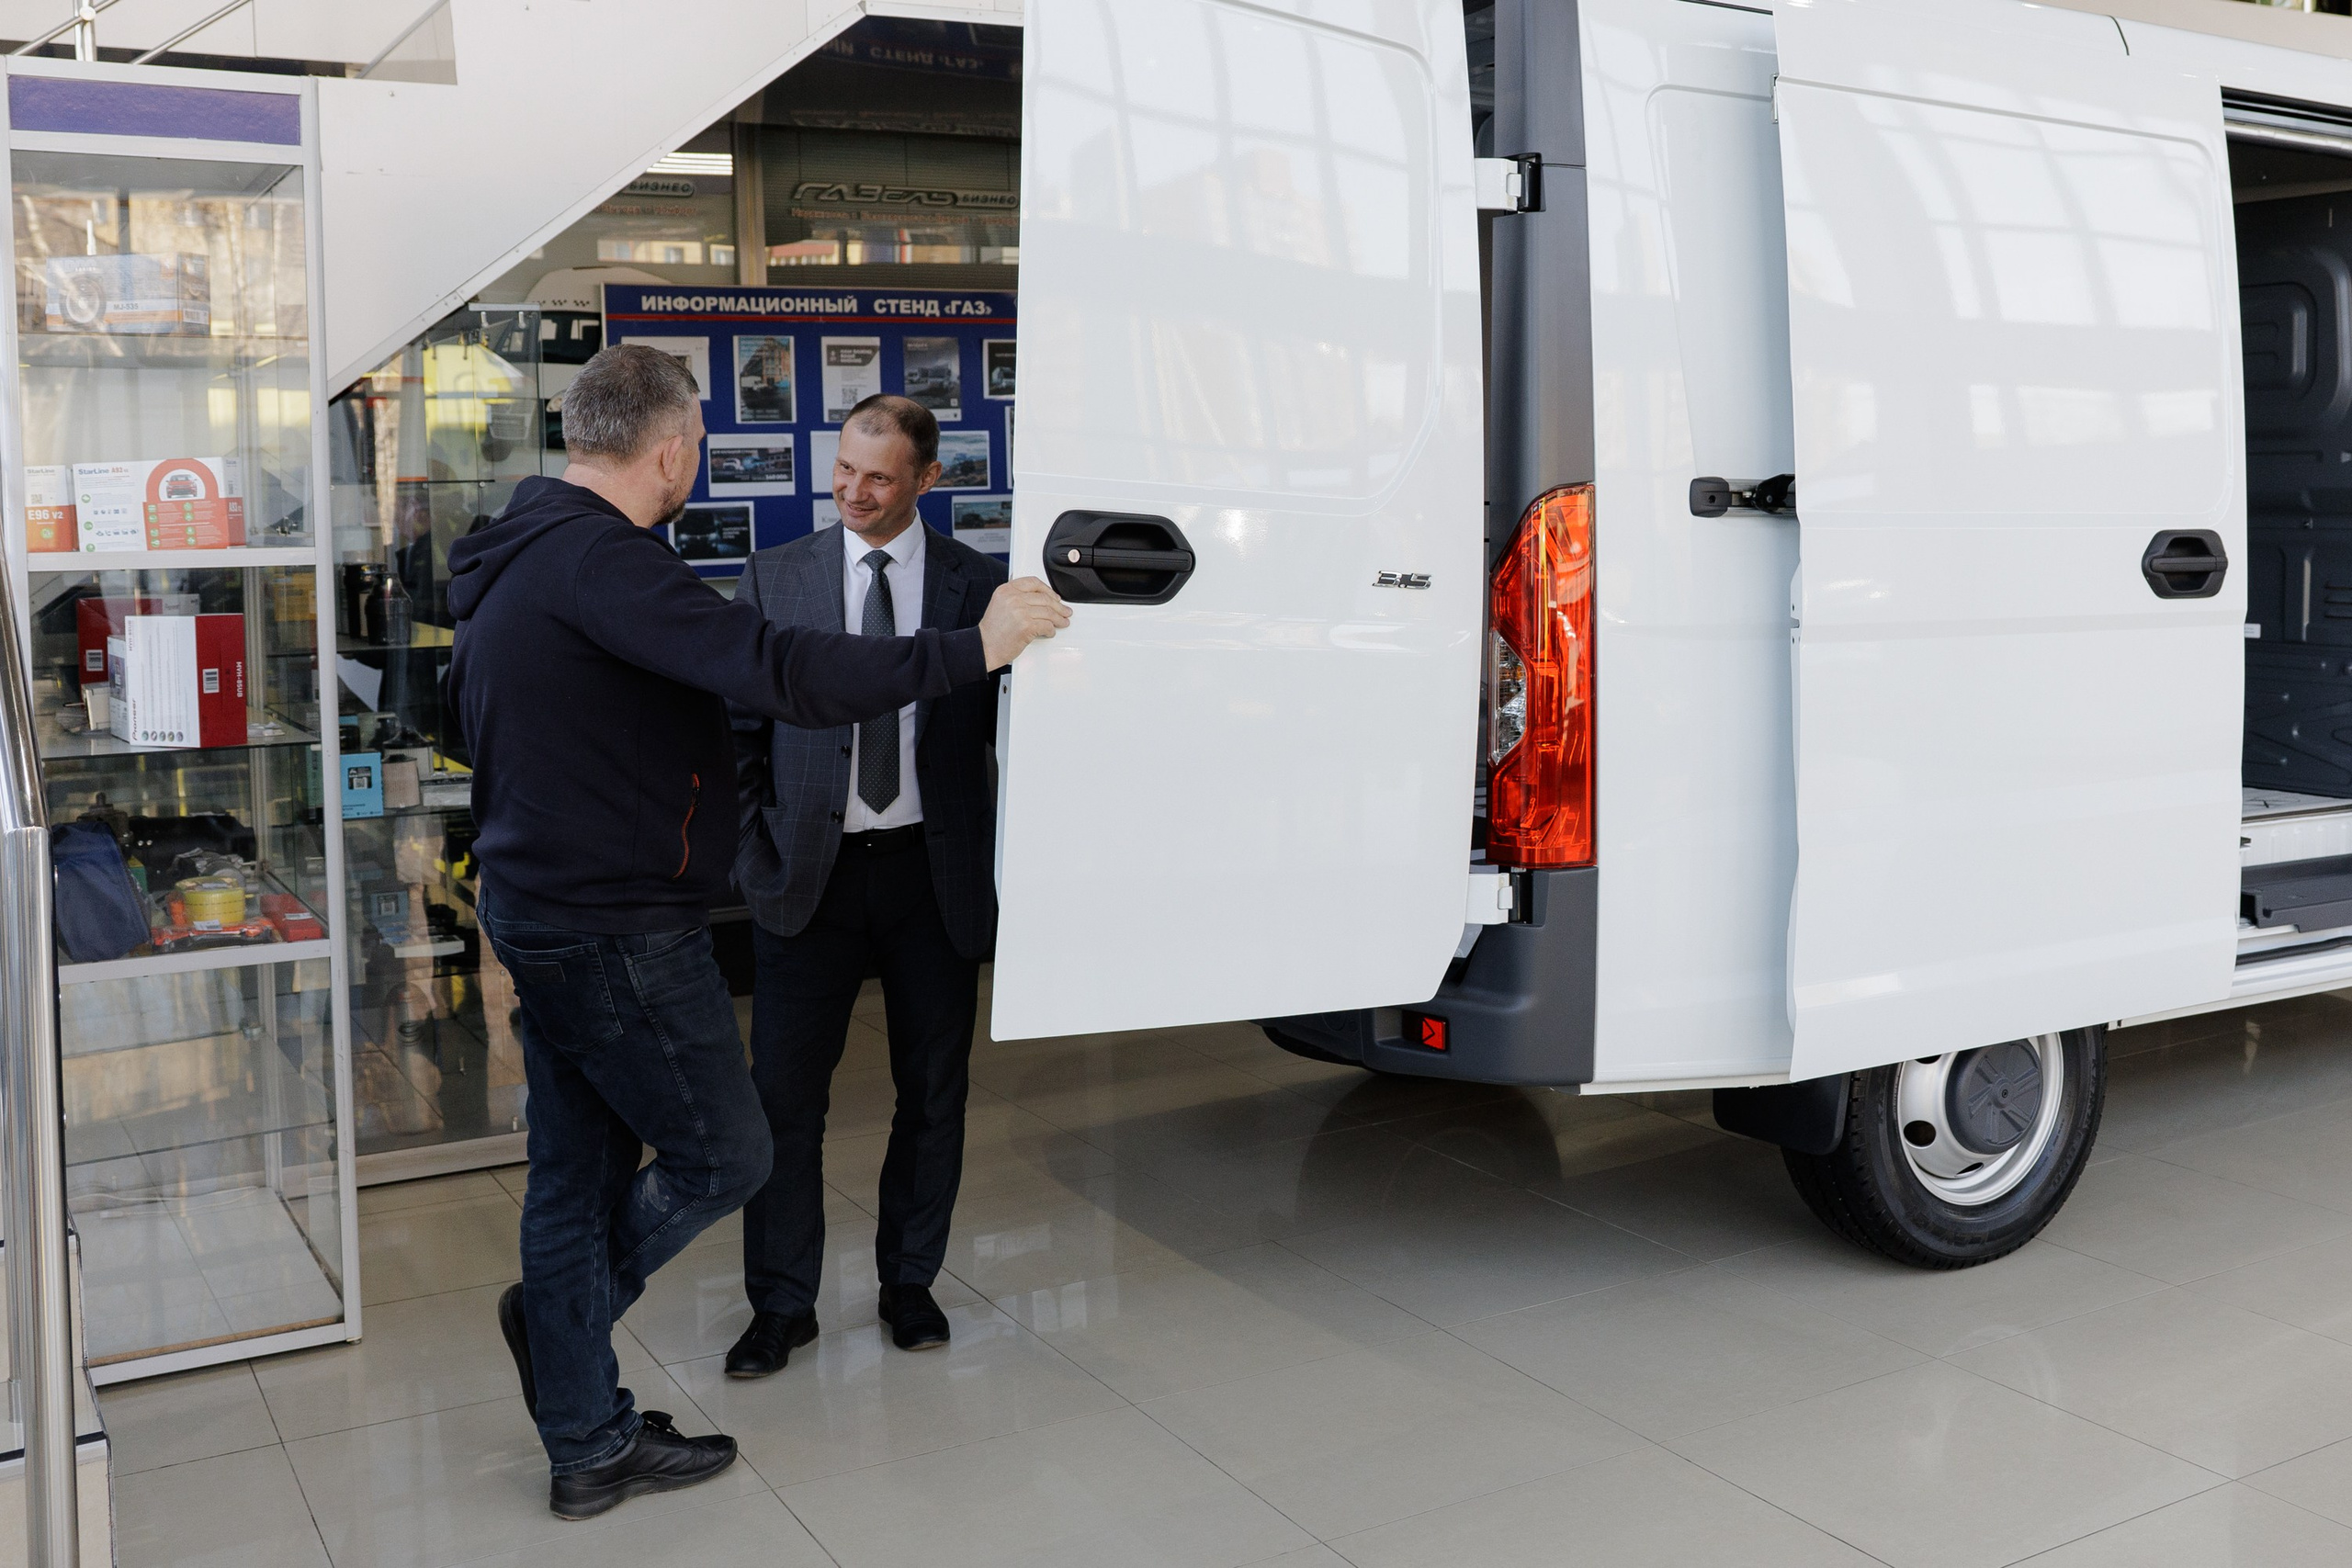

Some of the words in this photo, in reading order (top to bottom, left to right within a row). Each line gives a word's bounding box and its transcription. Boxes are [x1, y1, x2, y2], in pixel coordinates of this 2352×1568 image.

[641, 295, 858, 314] ИНФОРМАЦИОННЫЙ
[874, 299, 940, 317] СТЕНД
[944, 300, 992, 315] «ГАЗ»
[28, 510, 50, 520] E96
[1372, 570, 1431, 590] 3.5
